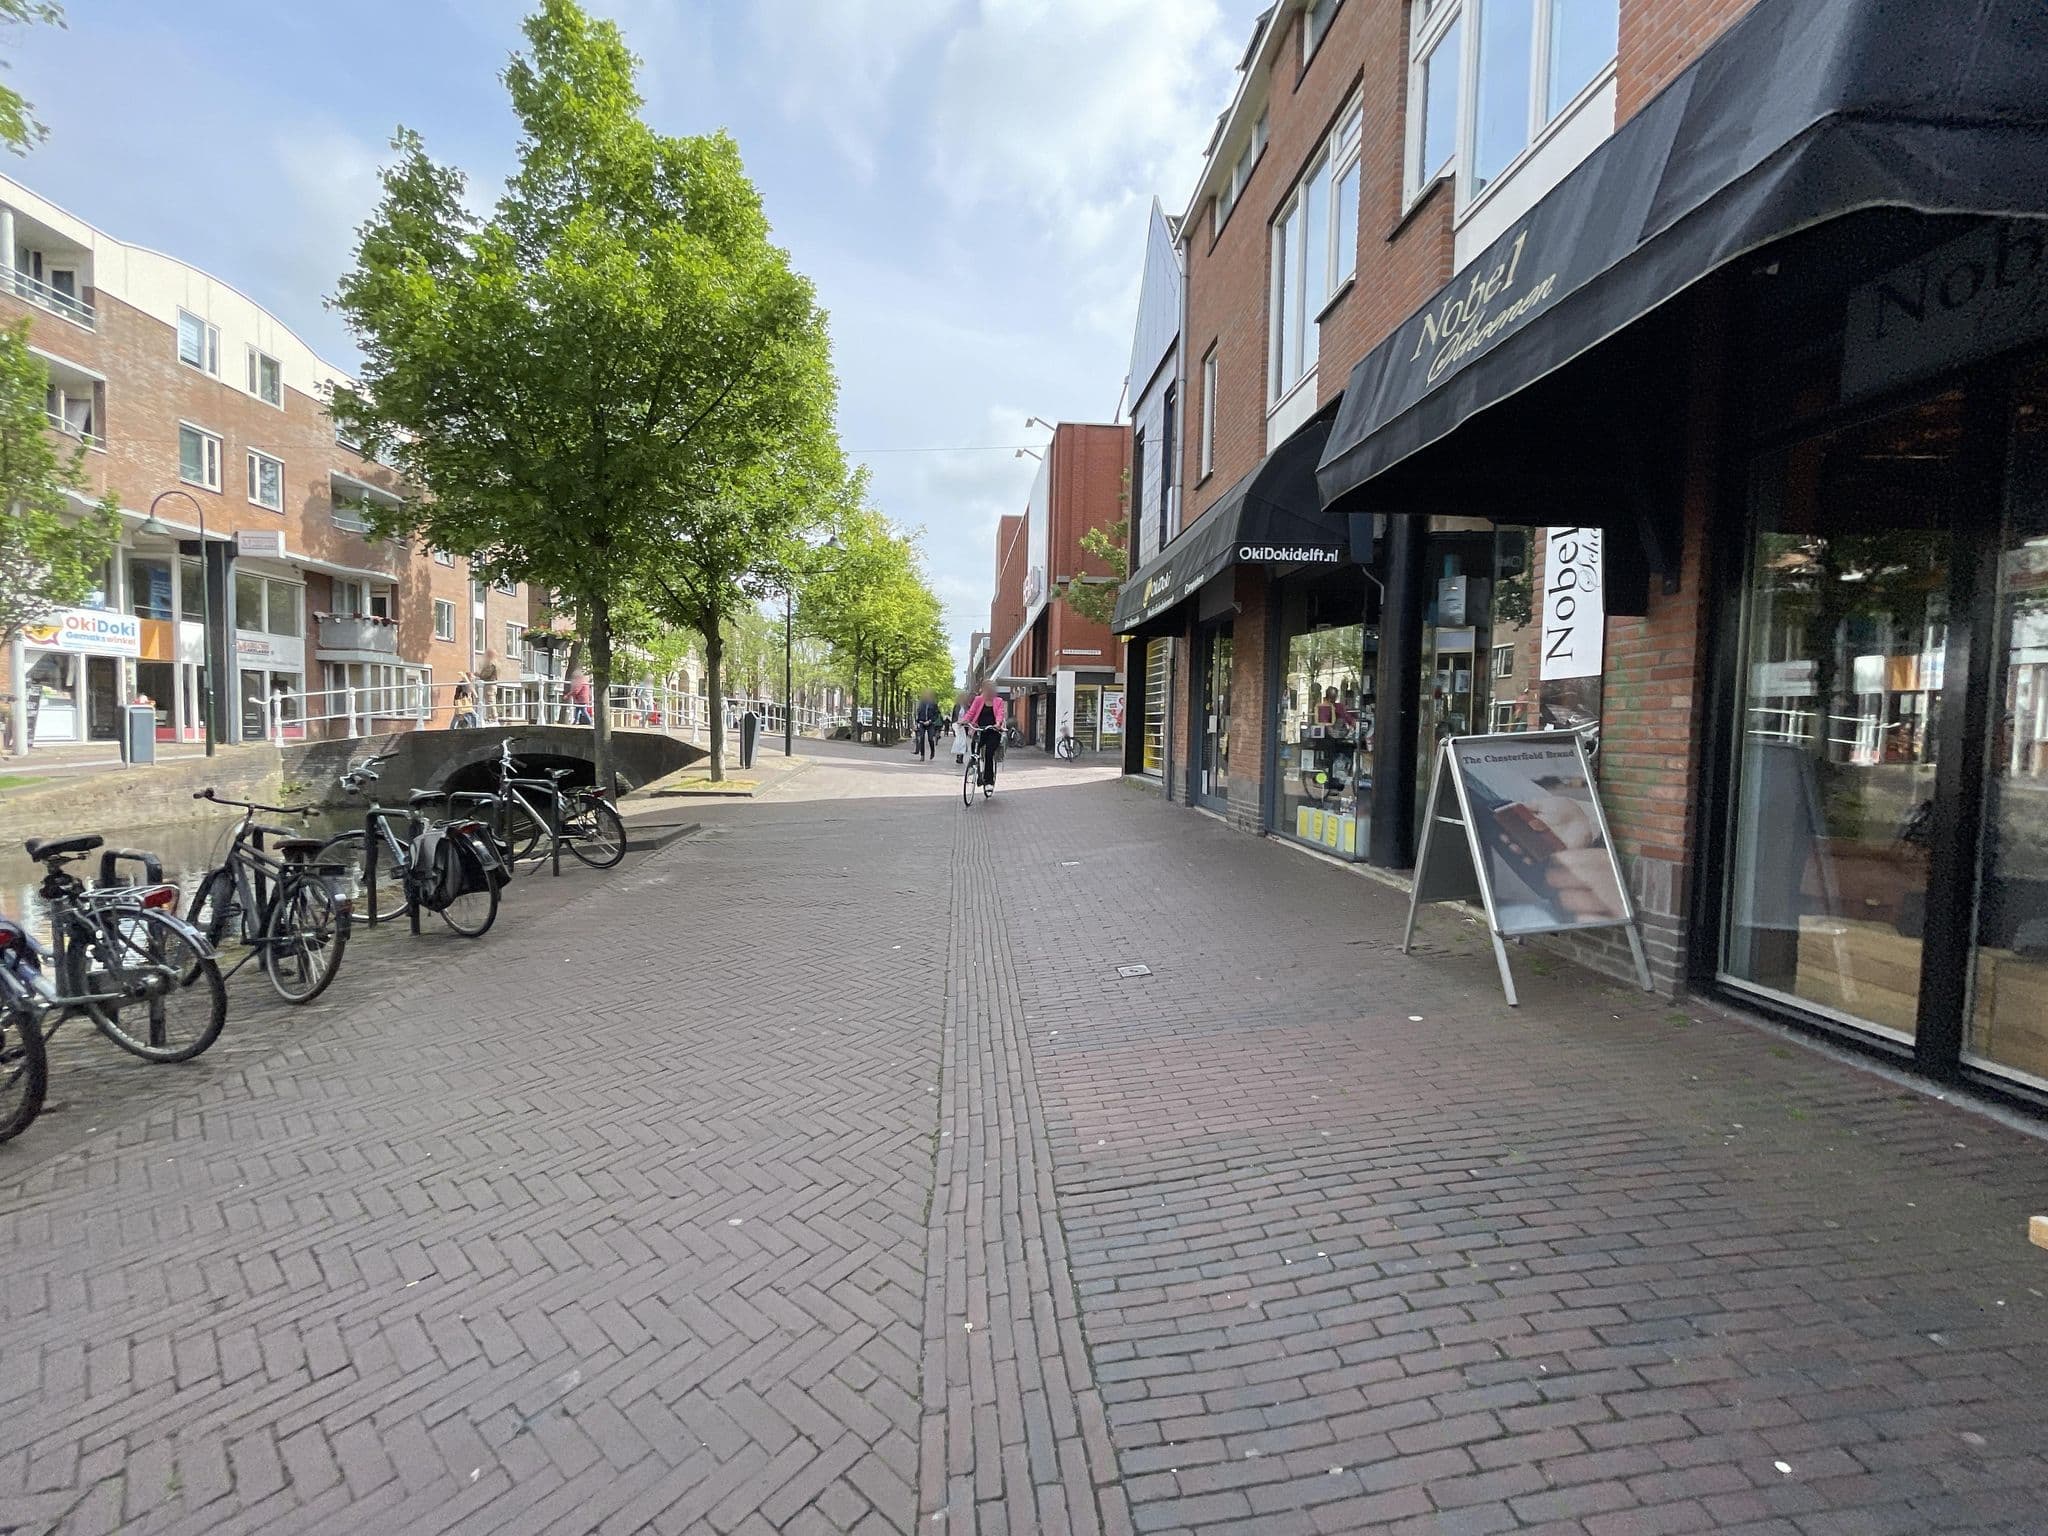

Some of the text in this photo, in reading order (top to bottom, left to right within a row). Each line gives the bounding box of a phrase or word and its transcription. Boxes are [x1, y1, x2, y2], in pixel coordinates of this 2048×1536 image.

[1410, 229, 1528, 362] Nobel
[1239, 546, 1339, 562] OkiDokidelft.nl
[1545, 527, 1579, 666] Nobel
[66, 616, 135, 636] OkiDoki
[1462, 756, 1482, 764] The
[1484, 751, 1543, 763] Chesterfield
